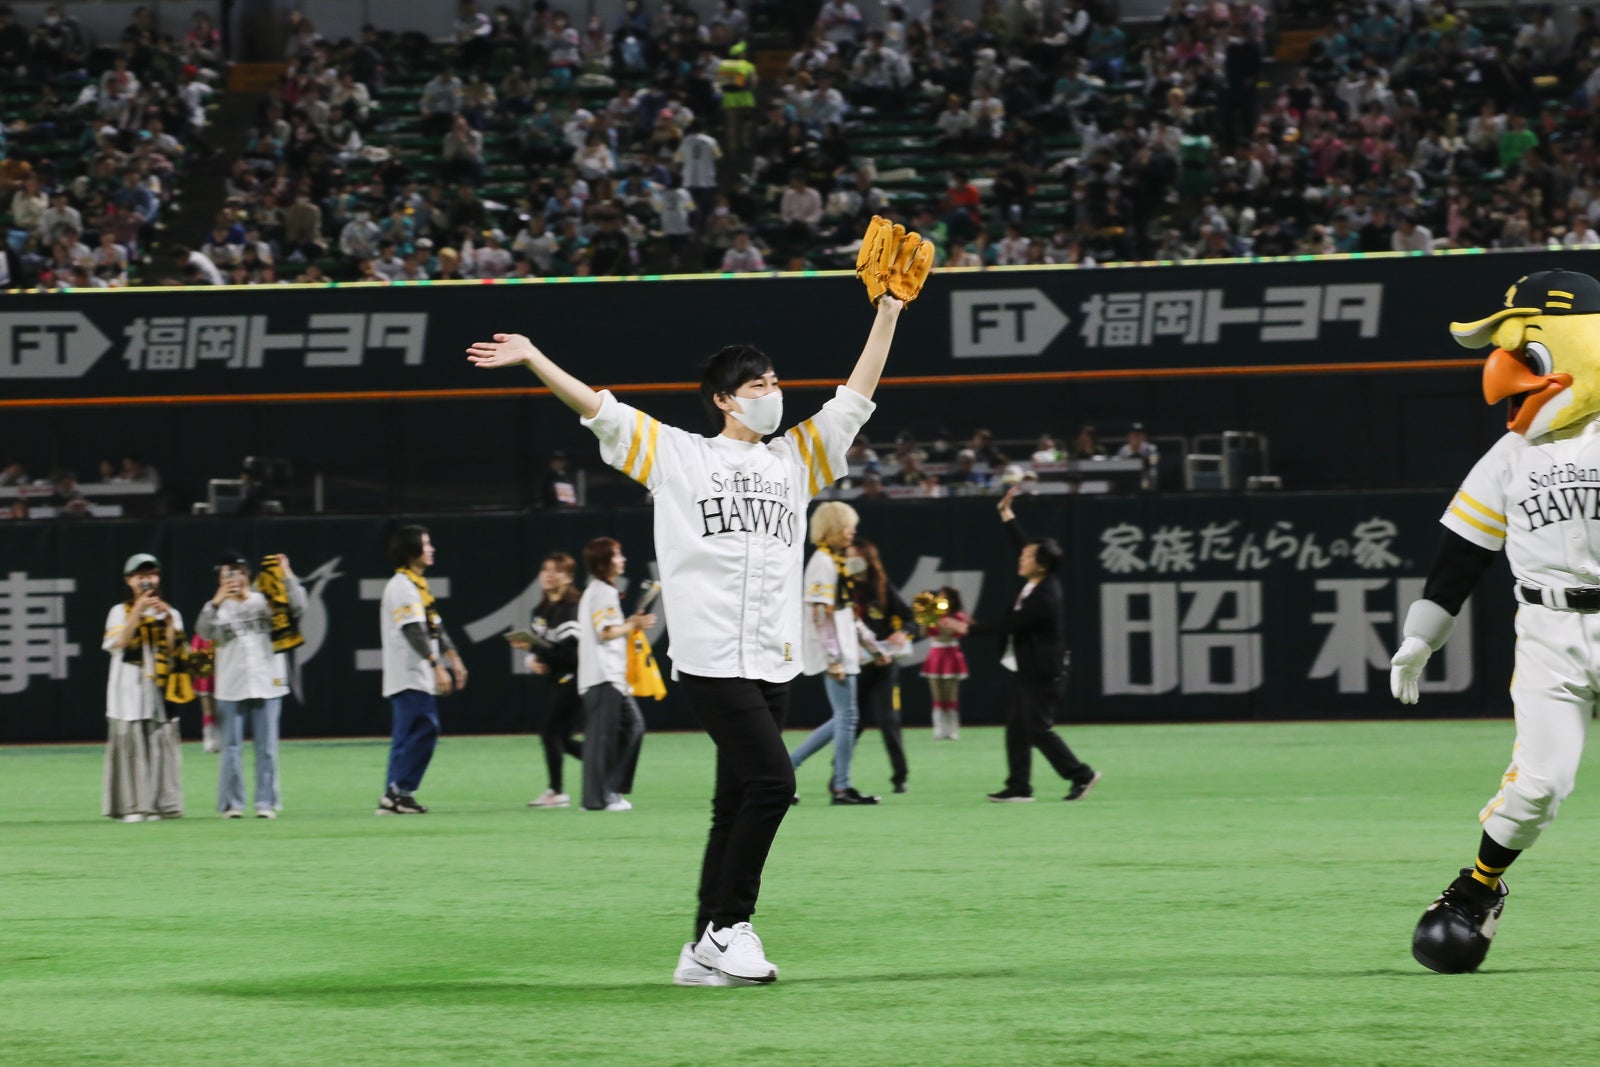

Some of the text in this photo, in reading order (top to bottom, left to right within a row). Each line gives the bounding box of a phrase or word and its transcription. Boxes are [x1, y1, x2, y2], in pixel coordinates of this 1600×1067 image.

[122, 312, 428, 371] 福岡トヨタ
[971, 301, 1036, 345] FT
[1079, 283, 1383, 348] 福岡トヨタ
[10, 324, 78, 366] FT
[697, 496, 793, 548] HAWKS
[1099, 517, 1401, 573] 家族だんらんの家
